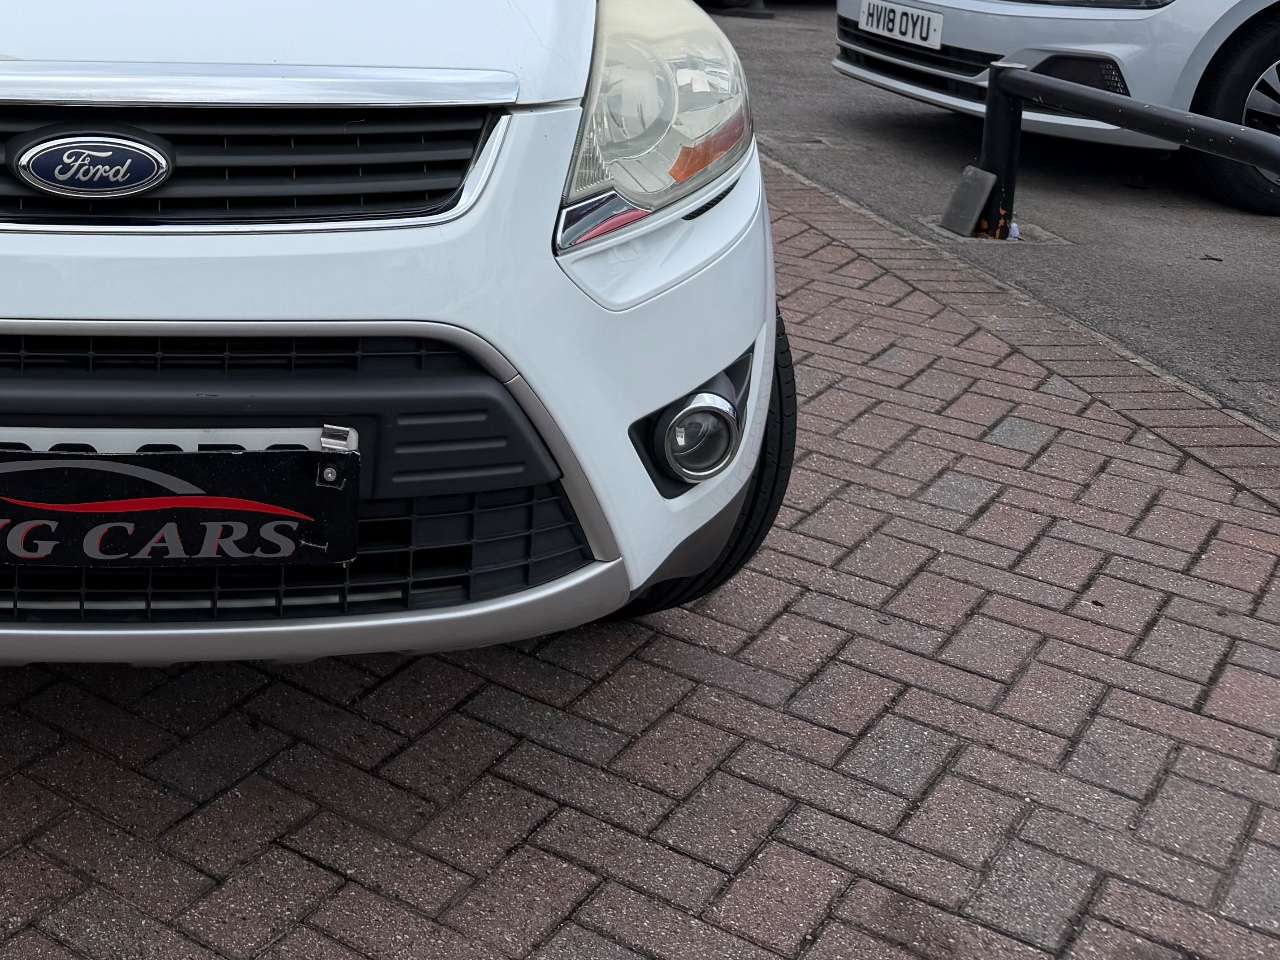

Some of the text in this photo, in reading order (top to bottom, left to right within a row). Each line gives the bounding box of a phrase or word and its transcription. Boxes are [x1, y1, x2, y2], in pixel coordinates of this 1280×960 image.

[866, 2, 931, 42] HV18 OYU
[54, 148, 132, 182] Ford
[82, 519, 301, 560] CARS
